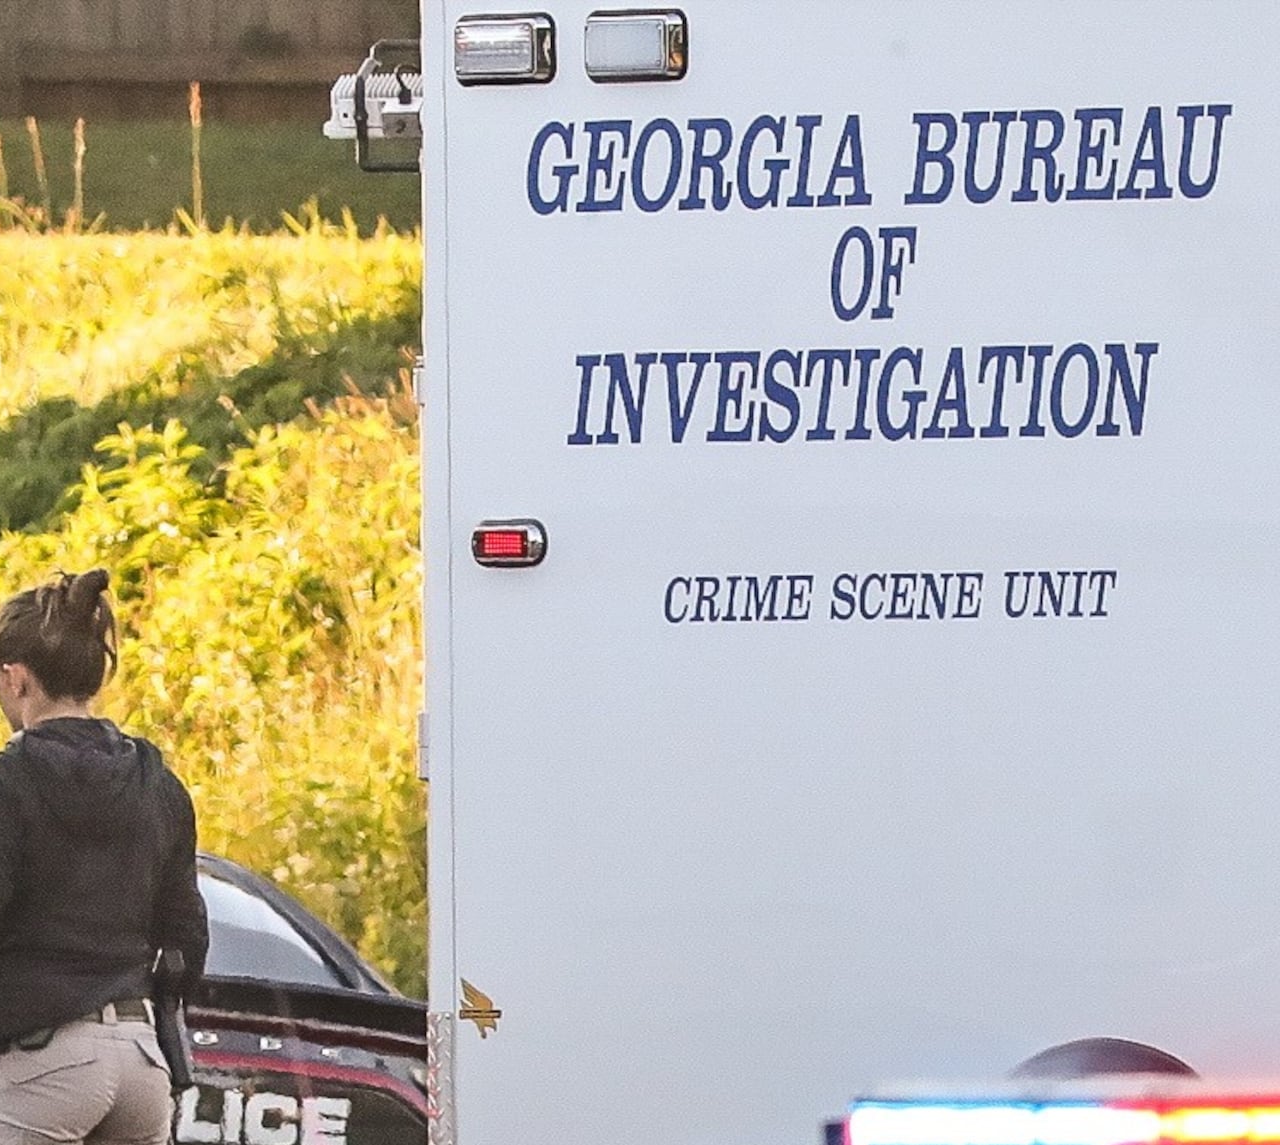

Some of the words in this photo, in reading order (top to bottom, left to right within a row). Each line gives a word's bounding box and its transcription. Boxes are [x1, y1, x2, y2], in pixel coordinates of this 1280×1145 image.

[527, 114, 873, 216] GEORGIA
[904, 103, 1234, 206] BUREAU
[830, 225, 918, 322] OF
[567, 342, 1160, 447] INVESTIGATION
[663, 574, 815, 625] CRIME
[829, 572, 985, 623] SCENE
[1002, 570, 1119, 620] UNIT
